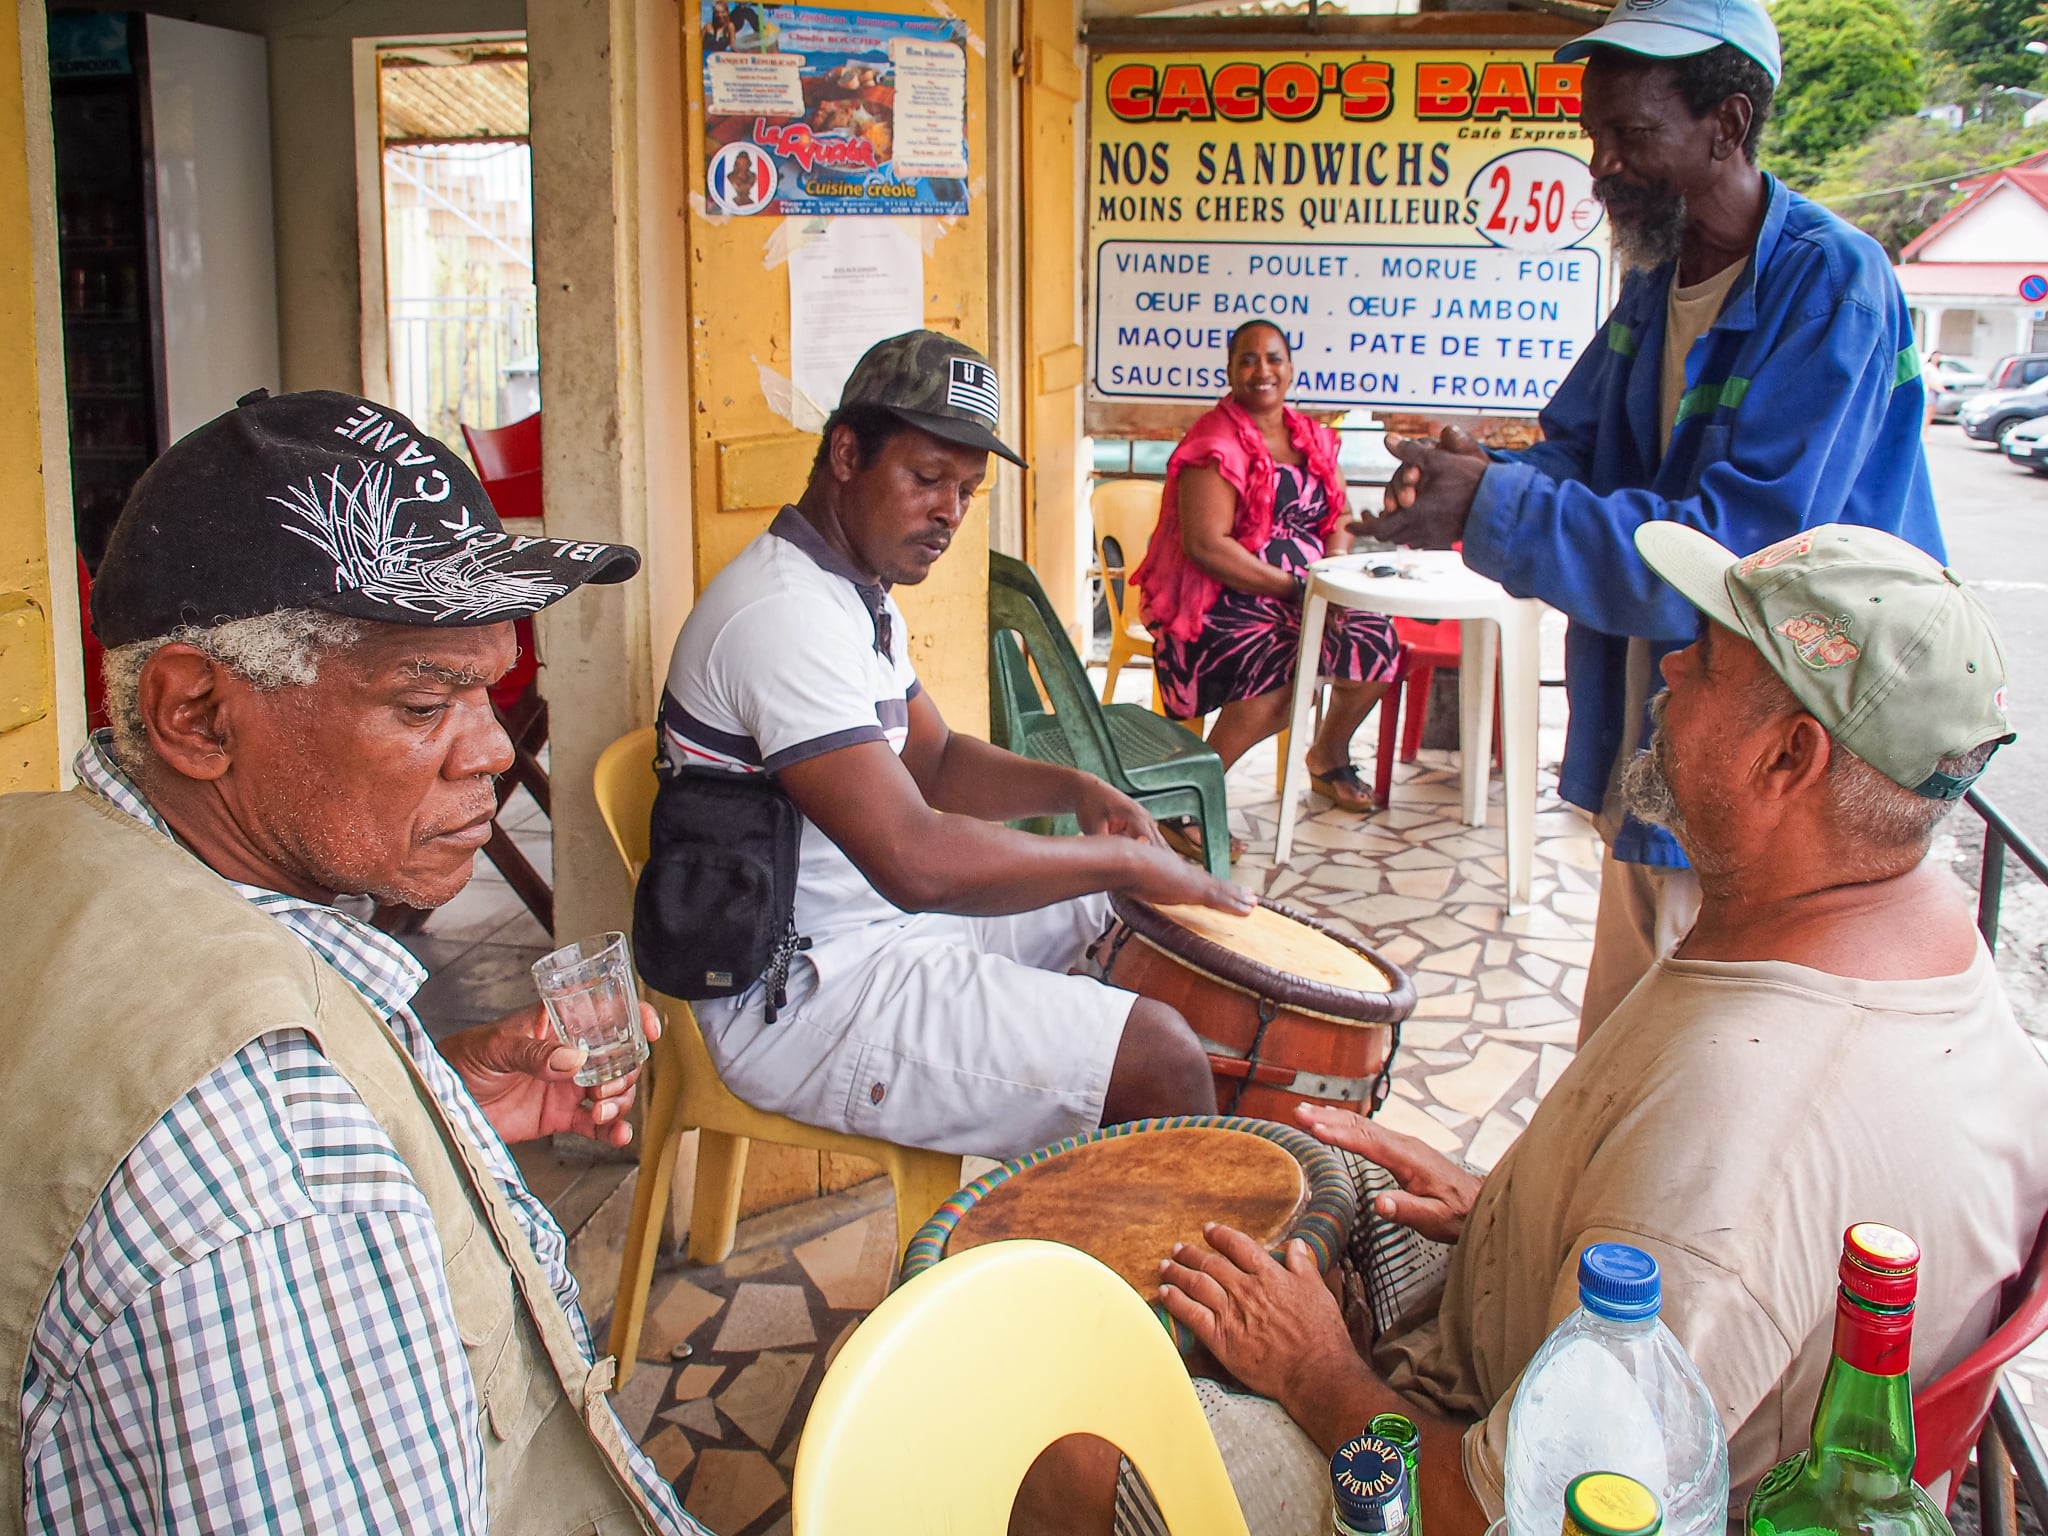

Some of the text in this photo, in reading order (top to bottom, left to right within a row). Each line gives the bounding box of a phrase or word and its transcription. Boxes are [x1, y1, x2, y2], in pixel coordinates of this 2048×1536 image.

[1106, 61, 1583, 122] CACO'S BAR
[1458, 127, 1501, 139] Café
[1099, 141, 1450, 187] NOS SANDWICHS
[806, 180, 916, 198] Cuisine créole
[1486, 165, 1565, 235] 2,50
[1098, 196, 1479, 230] MOINS CHERS QU'AILLEURS
[1116, 253, 1581, 282] VIANDE POULET MORUE FOIE
[1214, 294, 1309, 315] BACON
[1431, 298, 1558, 321] JAMBON
[1350, 333, 1426, 354] PATE
[1442, 336, 1479, 357] DE
[1497, 338, 1574, 360] TETE
[1295, 371, 1399, 393] AMBON
[334, 405, 450, 502] CANE
[1339, 1437, 1398, 1463] BOMBAY
[1336, 1468, 1396, 1497] BOMBAY
